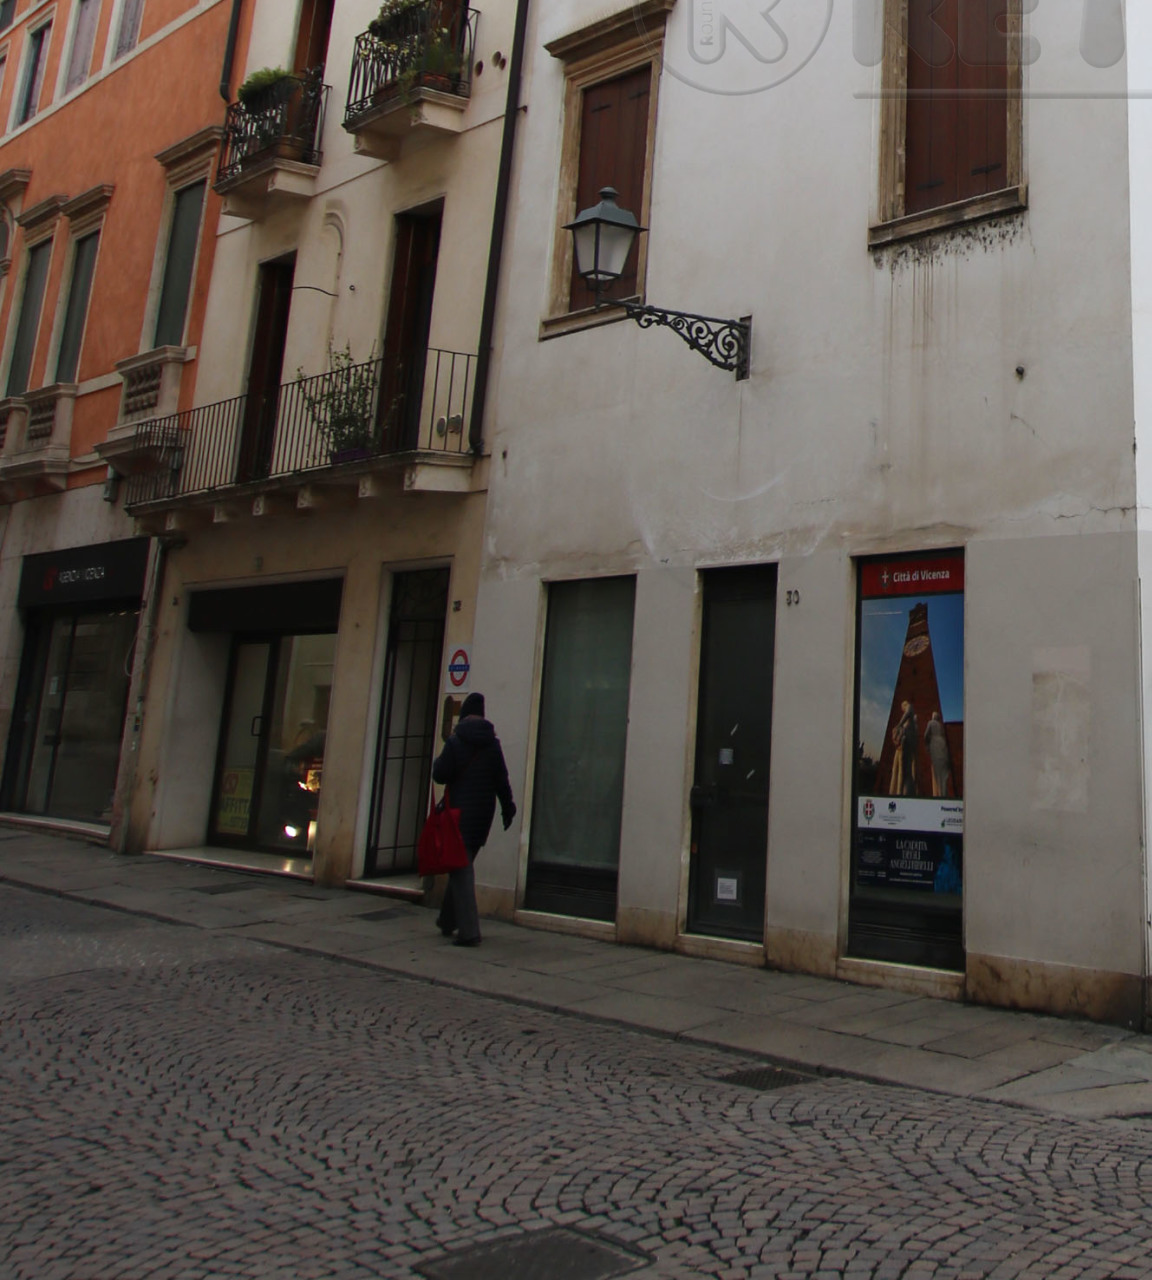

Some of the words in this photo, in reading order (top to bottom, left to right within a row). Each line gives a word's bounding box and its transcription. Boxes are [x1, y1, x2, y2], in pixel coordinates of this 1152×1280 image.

[893, 570, 910, 583] Città
[912, 570, 919, 582] di
[920, 569, 950, 581] Vicenza
[786, 589, 800, 607] 30
